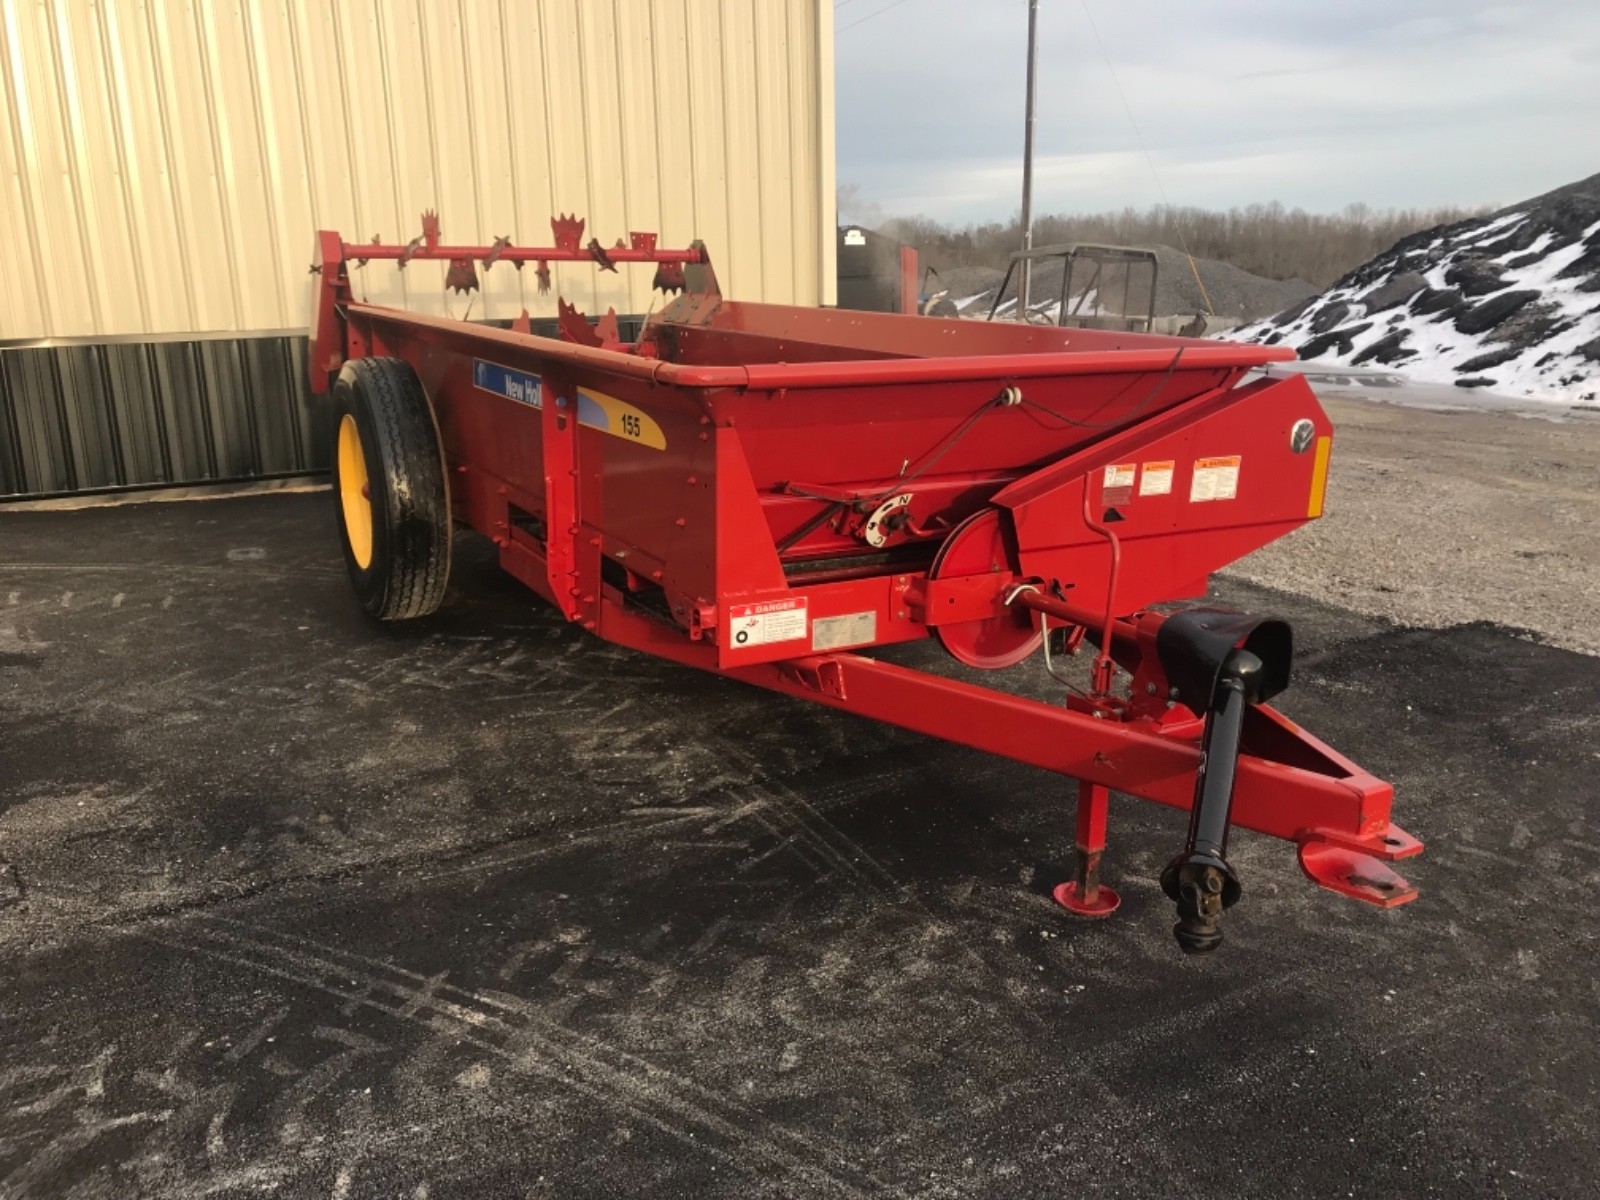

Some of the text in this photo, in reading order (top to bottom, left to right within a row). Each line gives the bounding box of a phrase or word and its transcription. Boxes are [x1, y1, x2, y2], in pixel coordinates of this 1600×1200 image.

[505, 374, 524, 401] New
[621, 413, 641, 437] 155
[755, 601, 795, 613] DANGER
